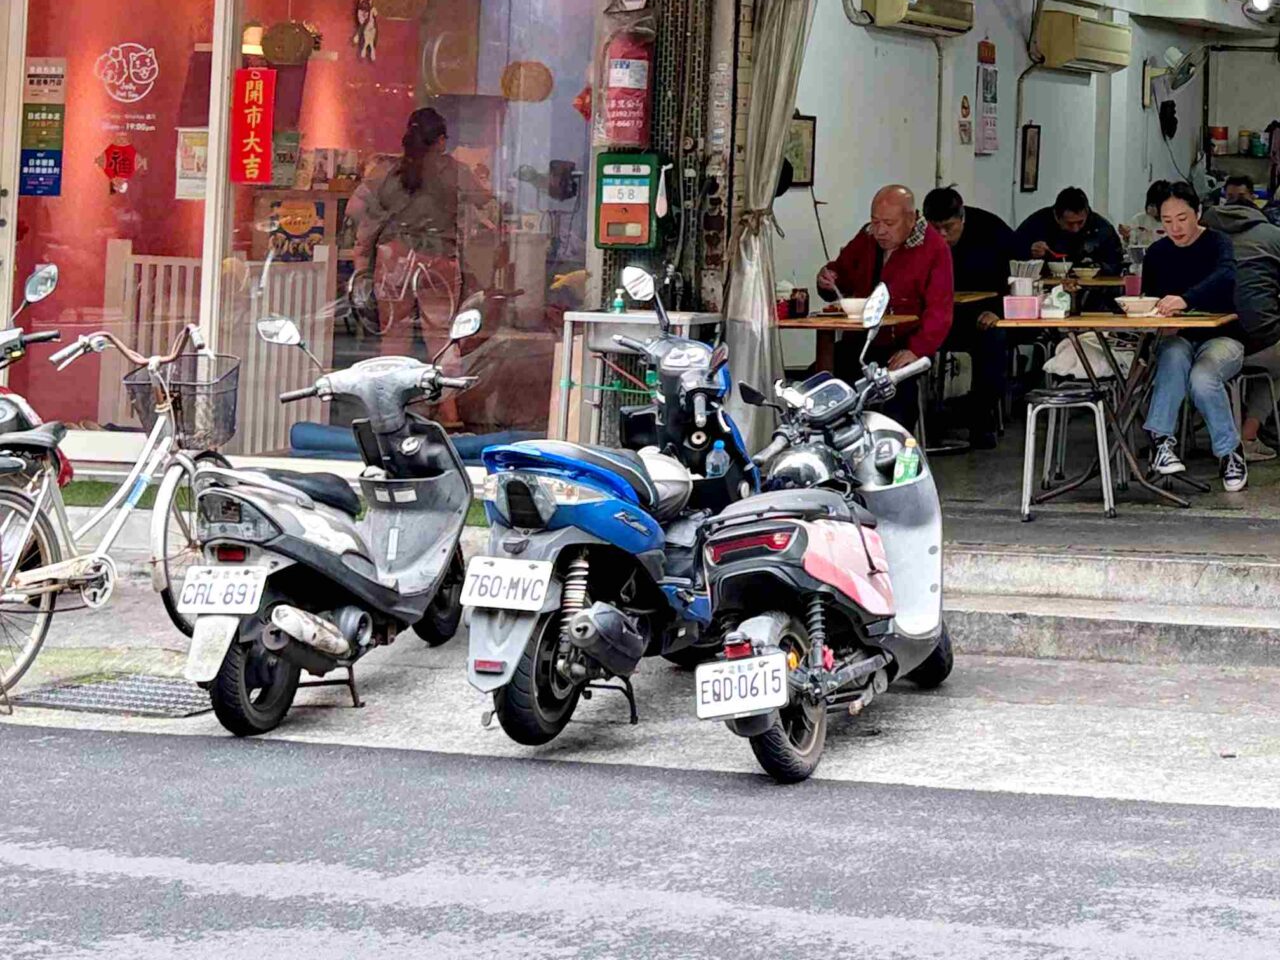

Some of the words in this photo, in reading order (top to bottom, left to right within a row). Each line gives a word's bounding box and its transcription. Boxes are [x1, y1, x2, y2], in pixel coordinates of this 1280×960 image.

[242, 79, 264, 179] 開市大吉
[617, 189, 636, 200] 58
